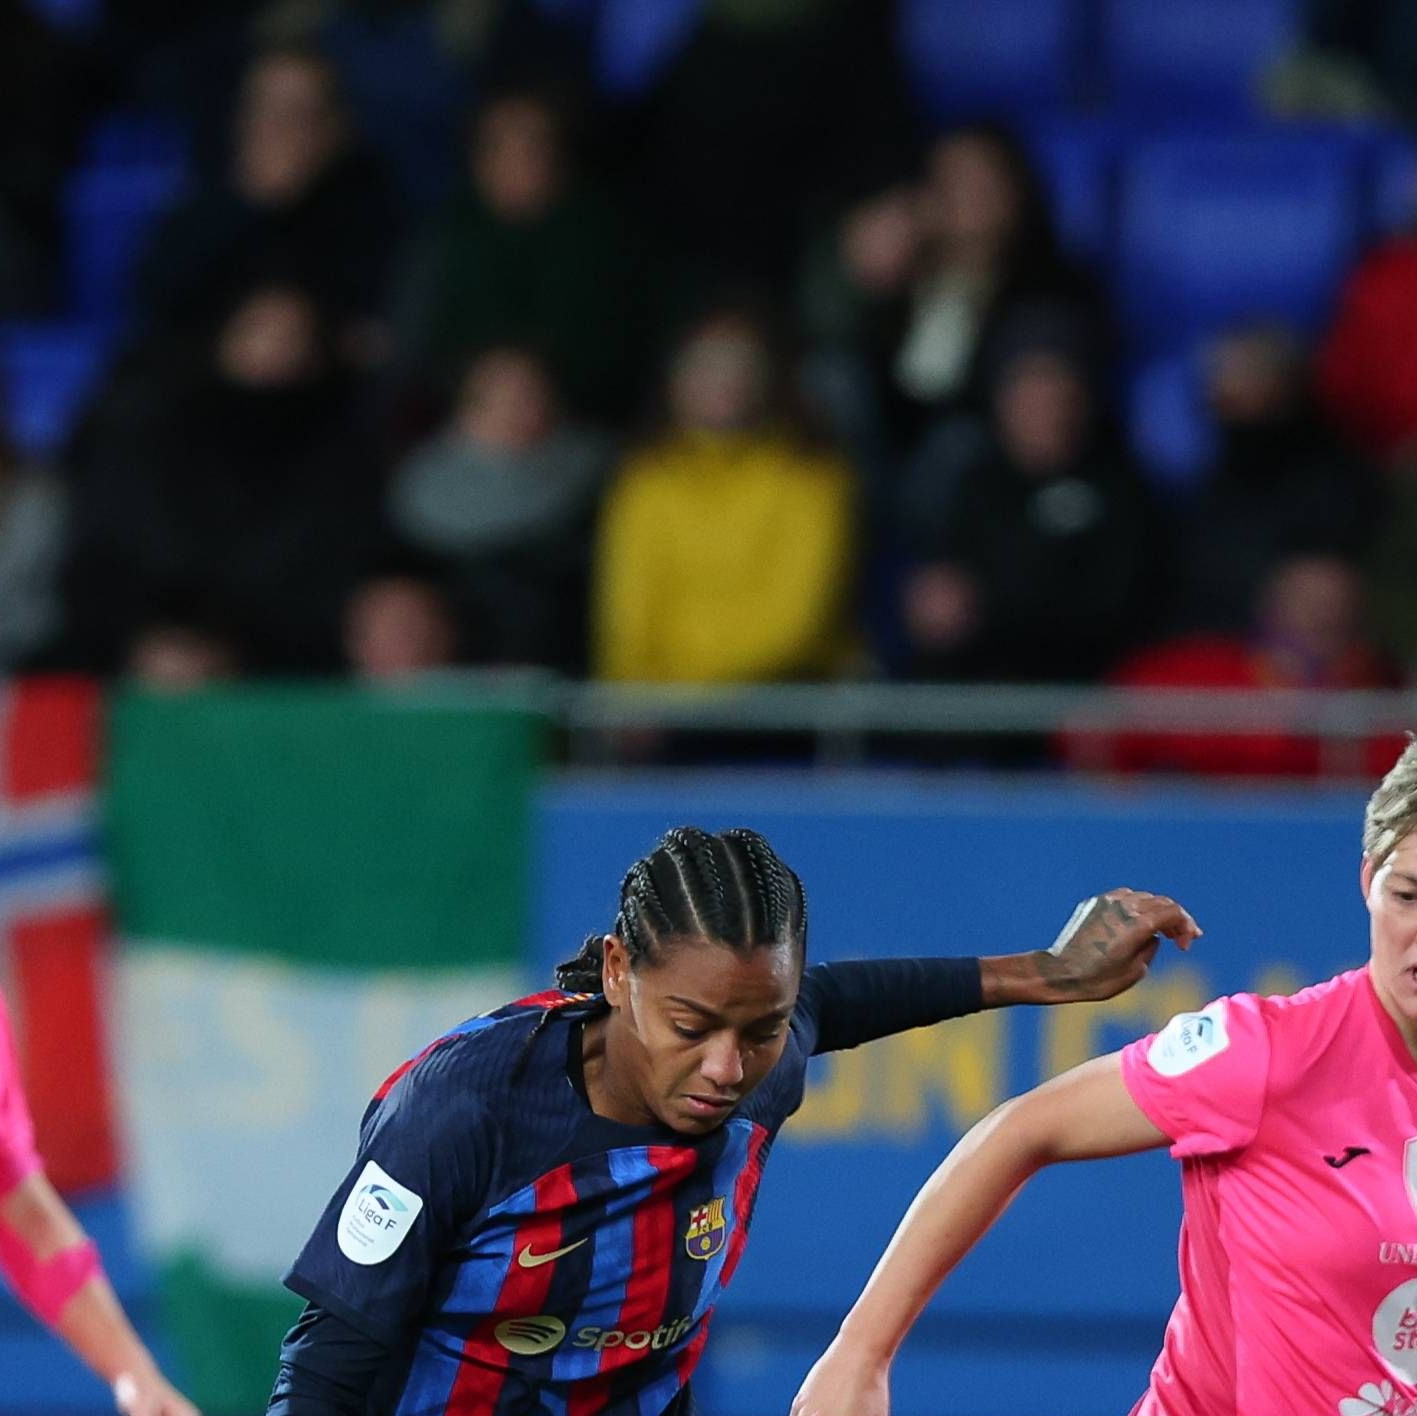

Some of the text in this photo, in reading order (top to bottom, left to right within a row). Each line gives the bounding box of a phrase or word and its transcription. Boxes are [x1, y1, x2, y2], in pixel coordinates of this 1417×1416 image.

[358, 1198, 383, 1225] Liga
[385, 1219, 397, 1231] F
[572, 1315, 691, 1352] Spotif
